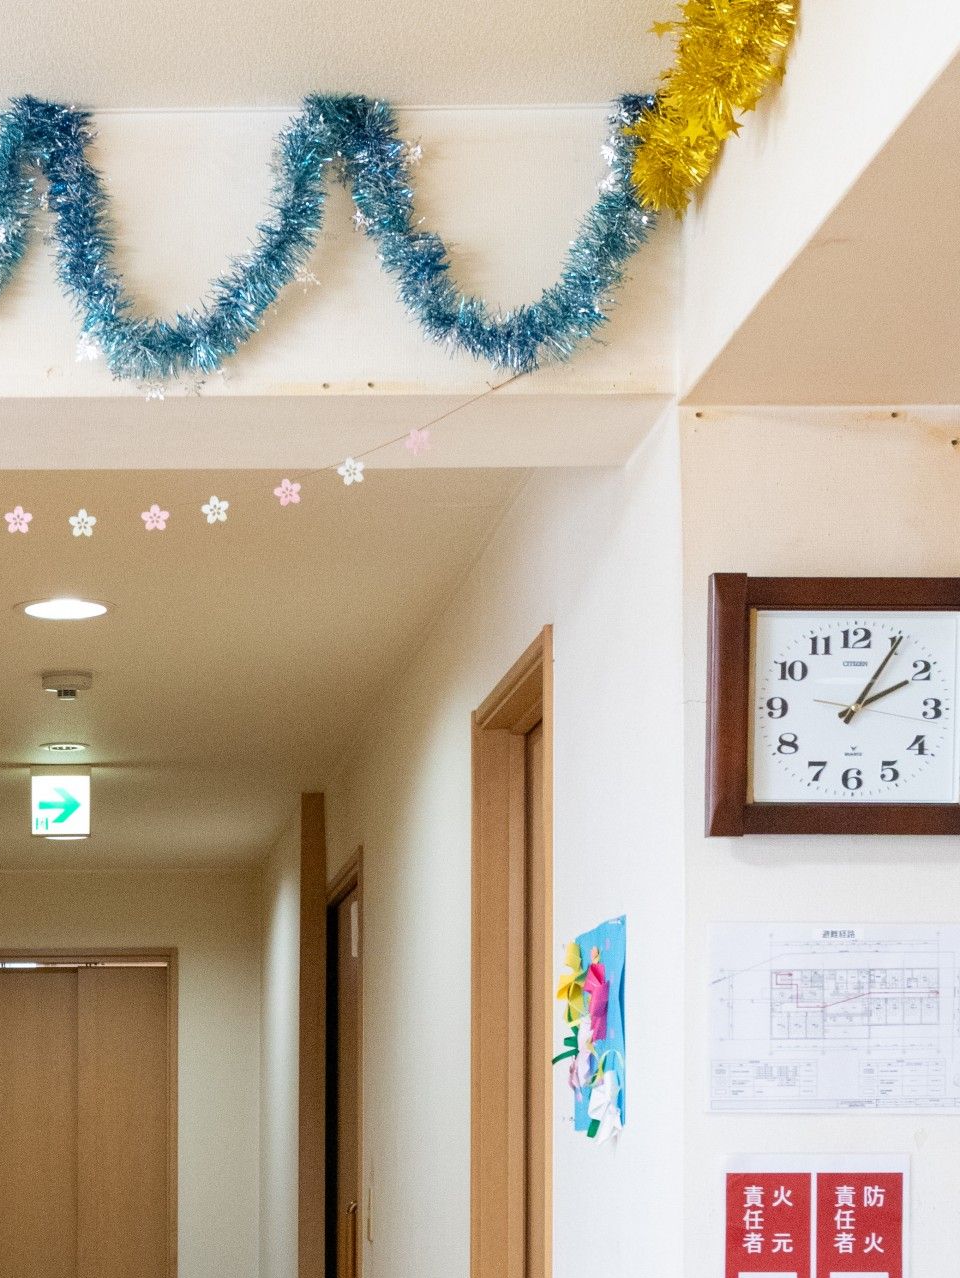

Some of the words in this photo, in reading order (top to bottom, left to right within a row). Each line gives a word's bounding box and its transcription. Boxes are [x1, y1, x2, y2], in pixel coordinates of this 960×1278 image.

[808, 635, 832, 656] 11
[840, 627, 872, 649] 12
[777, 659, 809, 681] 10
[911, 659, 932, 681] 2
[766, 696, 789, 719] 9
[922, 697, 942, 720] 3
[776, 732, 800, 755] 8
[906, 734, 929, 756] 4
[807, 760, 827, 782] 7
[841, 767, 863, 790] 6
[880, 759, 900, 782] 5
[742, 1185, 765, 1254] 責任者
[833, 1185, 856, 1254] 責任者
